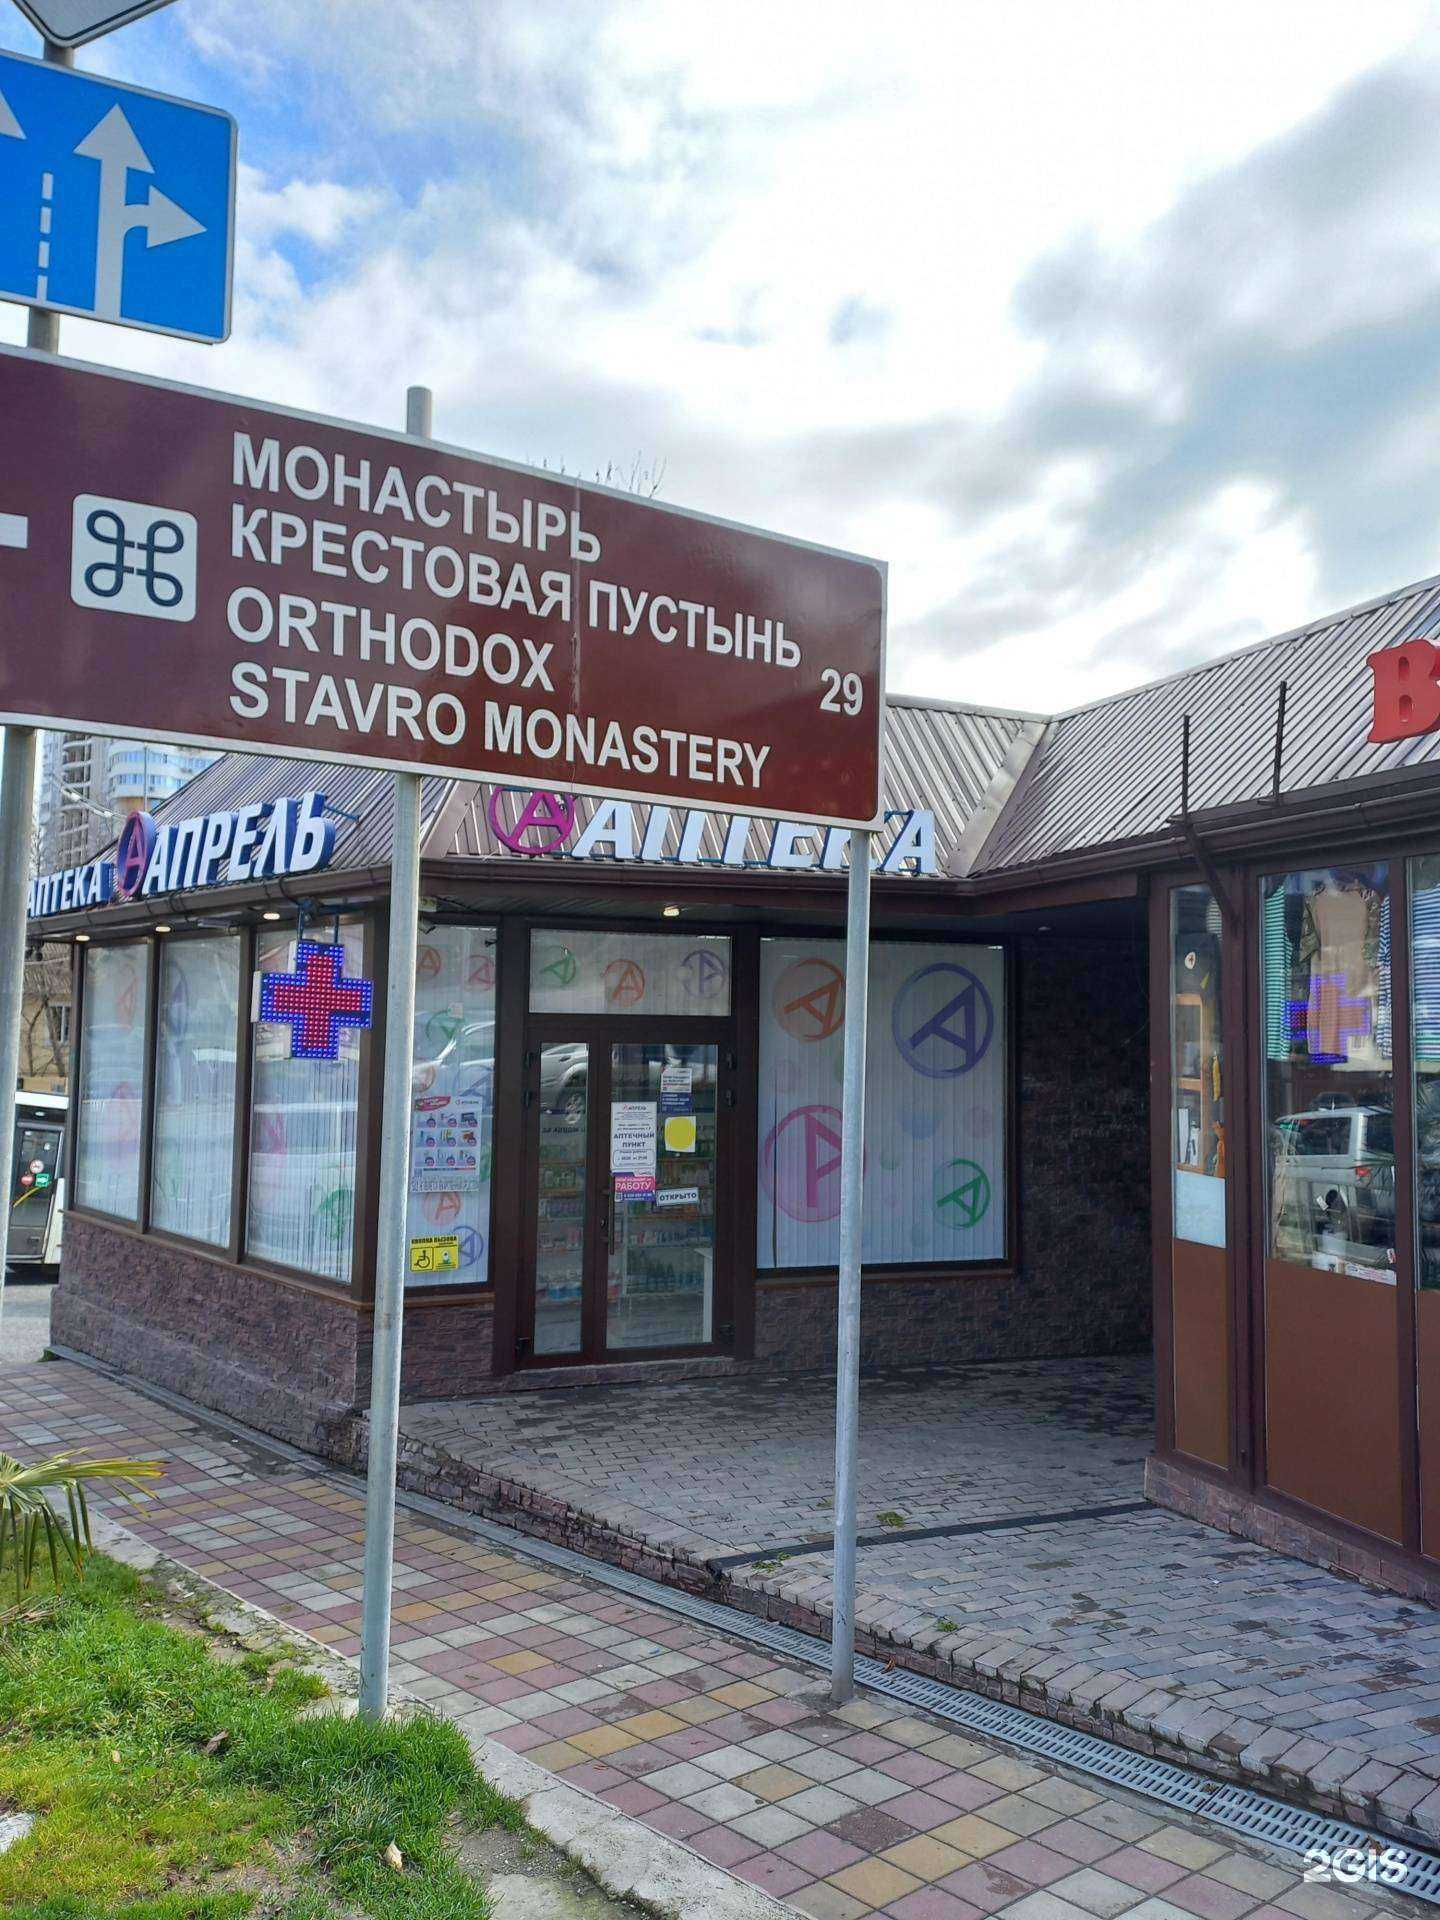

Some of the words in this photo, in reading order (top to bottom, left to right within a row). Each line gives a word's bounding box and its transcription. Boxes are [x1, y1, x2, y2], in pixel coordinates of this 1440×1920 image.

[232, 431, 603, 564] МОНАСТЫРЬ
[230, 503, 573, 622] КРЕСТОВАЯ
[587, 579, 802, 668] ПУСТЫНЬ
[226, 585, 556, 693] ORTHODOX
[229, 660, 467, 746] STAVRO
[484, 700, 771, 789] MONASTERY
[819, 667, 864, 717] 29
[142, 792, 328, 895] АПРЕЛЬ
[613, 1132, 655, 1140] АПТЕЧНЫЙ
[615, 1181, 652, 1191] РАБОТУ
[659, 1192, 697, 1202] ОТКРЫТО
